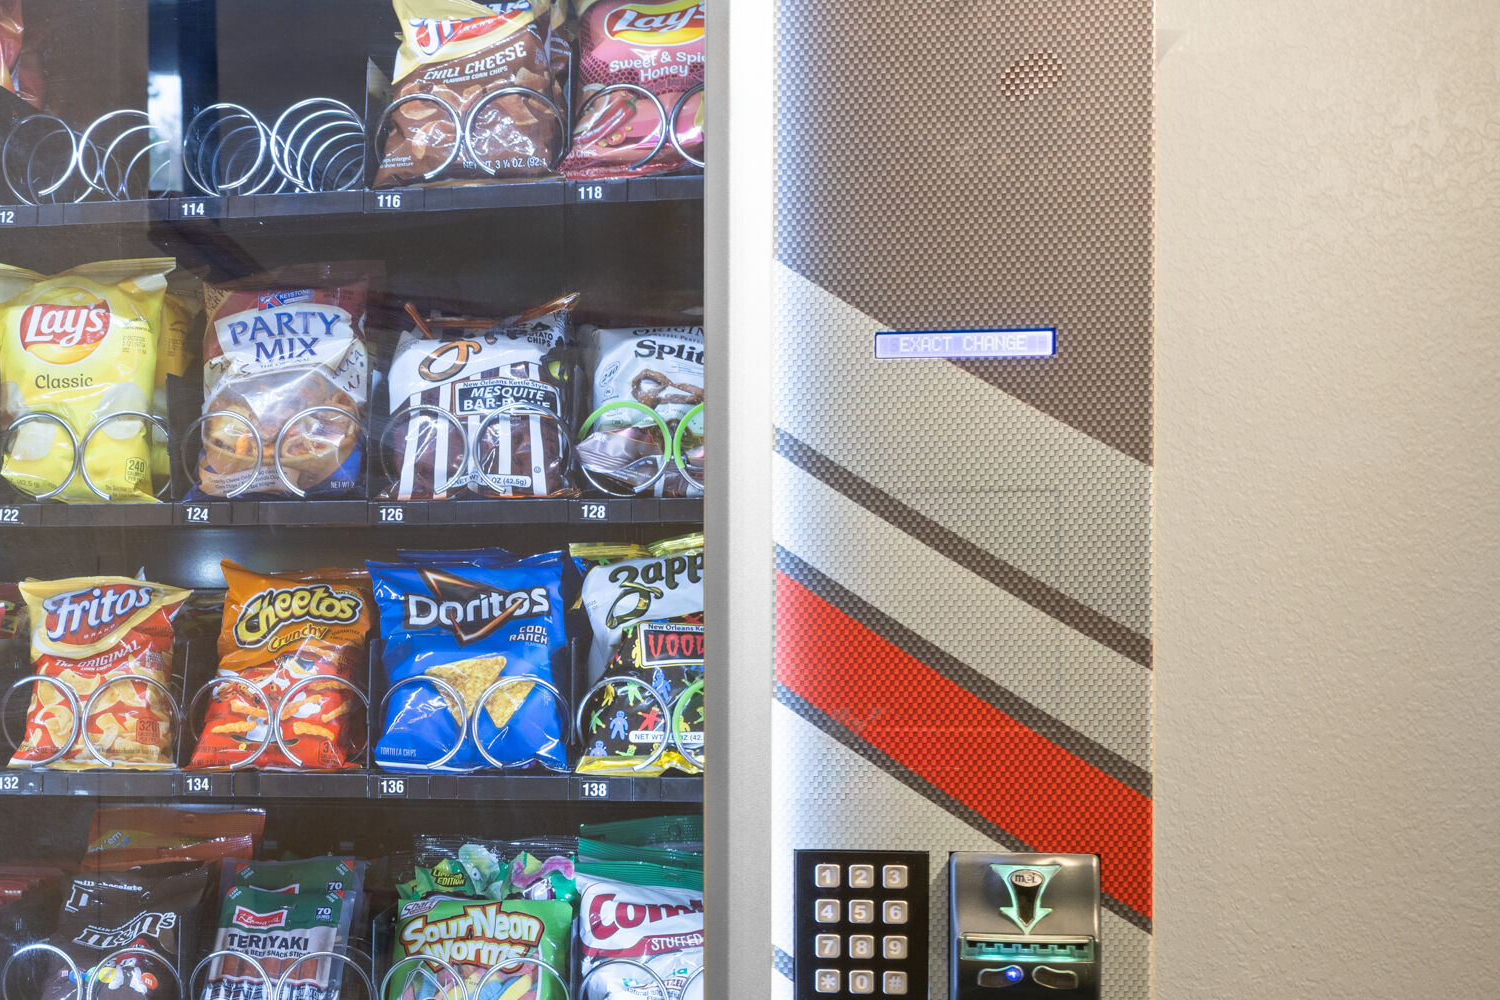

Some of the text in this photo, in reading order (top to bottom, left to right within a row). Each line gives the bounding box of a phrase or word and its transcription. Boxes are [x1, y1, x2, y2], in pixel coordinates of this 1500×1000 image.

[612, 1, 704, 32] Lay'
[424, 41, 527, 80] CHILI CHEESE
[609, 57, 656, 73] Sweet
[660, 51, 672, 63] &
[640, 65, 689, 81] Honey
[578, 186, 602, 199] 118
[377, 195, 401, 208] 116
[182, 203, 205, 216] 114
[25, 302, 110, 347] Lay's
[228, 312, 340, 345] PARTY
[527, 337, 551, 347] CHIPS
[900, 335, 1027, 353] EXACT CHANGE
[255, 338, 319, 362] MIX
[34, 374, 94, 390] Classic
[470, 386, 545, 400] MESQUITE
[128, 460, 145, 473] 240
[187, 507, 209, 521] 124
[380, 508, 403, 521] 126
[582, 506, 605, 520] 128
[43, 586, 154, 642] Fritos
[409, 588, 550, 626] Doritos
[237, 587, 357, 643] Cheetos
[84, 624, 116, 640] BRAND
[519, 626, 548, 636] COOL
[666, 624, 694, 632] Orleans
[269, 623, 329, 652] Crunchy
[509, 633, 548, 645] RANCH
[55, 640, 142, 667] The ORIGINAL
[139, 720, 157, 732] 320
[186, 778, 209, 791] 134
[380, 780, 404, 794] 136
[582, 782, 607, 797] 138
[437, 877, 465, 886] EDITION
[822, 869, 900, 884] 1 2 3
[328, 882, 343, 891] 70
[821, 904, 901, 920] 4 5 6
[402, 905, 540, 953] Sour Neon
[228, 934, 309, 951] TERIYAKI
[651, 934, 703, 951] STUFFED
[822, 940, 900, 955] 7 8 9
[251, 950, 265, 958] BEEF
[267, 950, 288, 958] SNACK
[420, 941, 524, 970] Worms
[856, 975, 900, 990] 0 #
